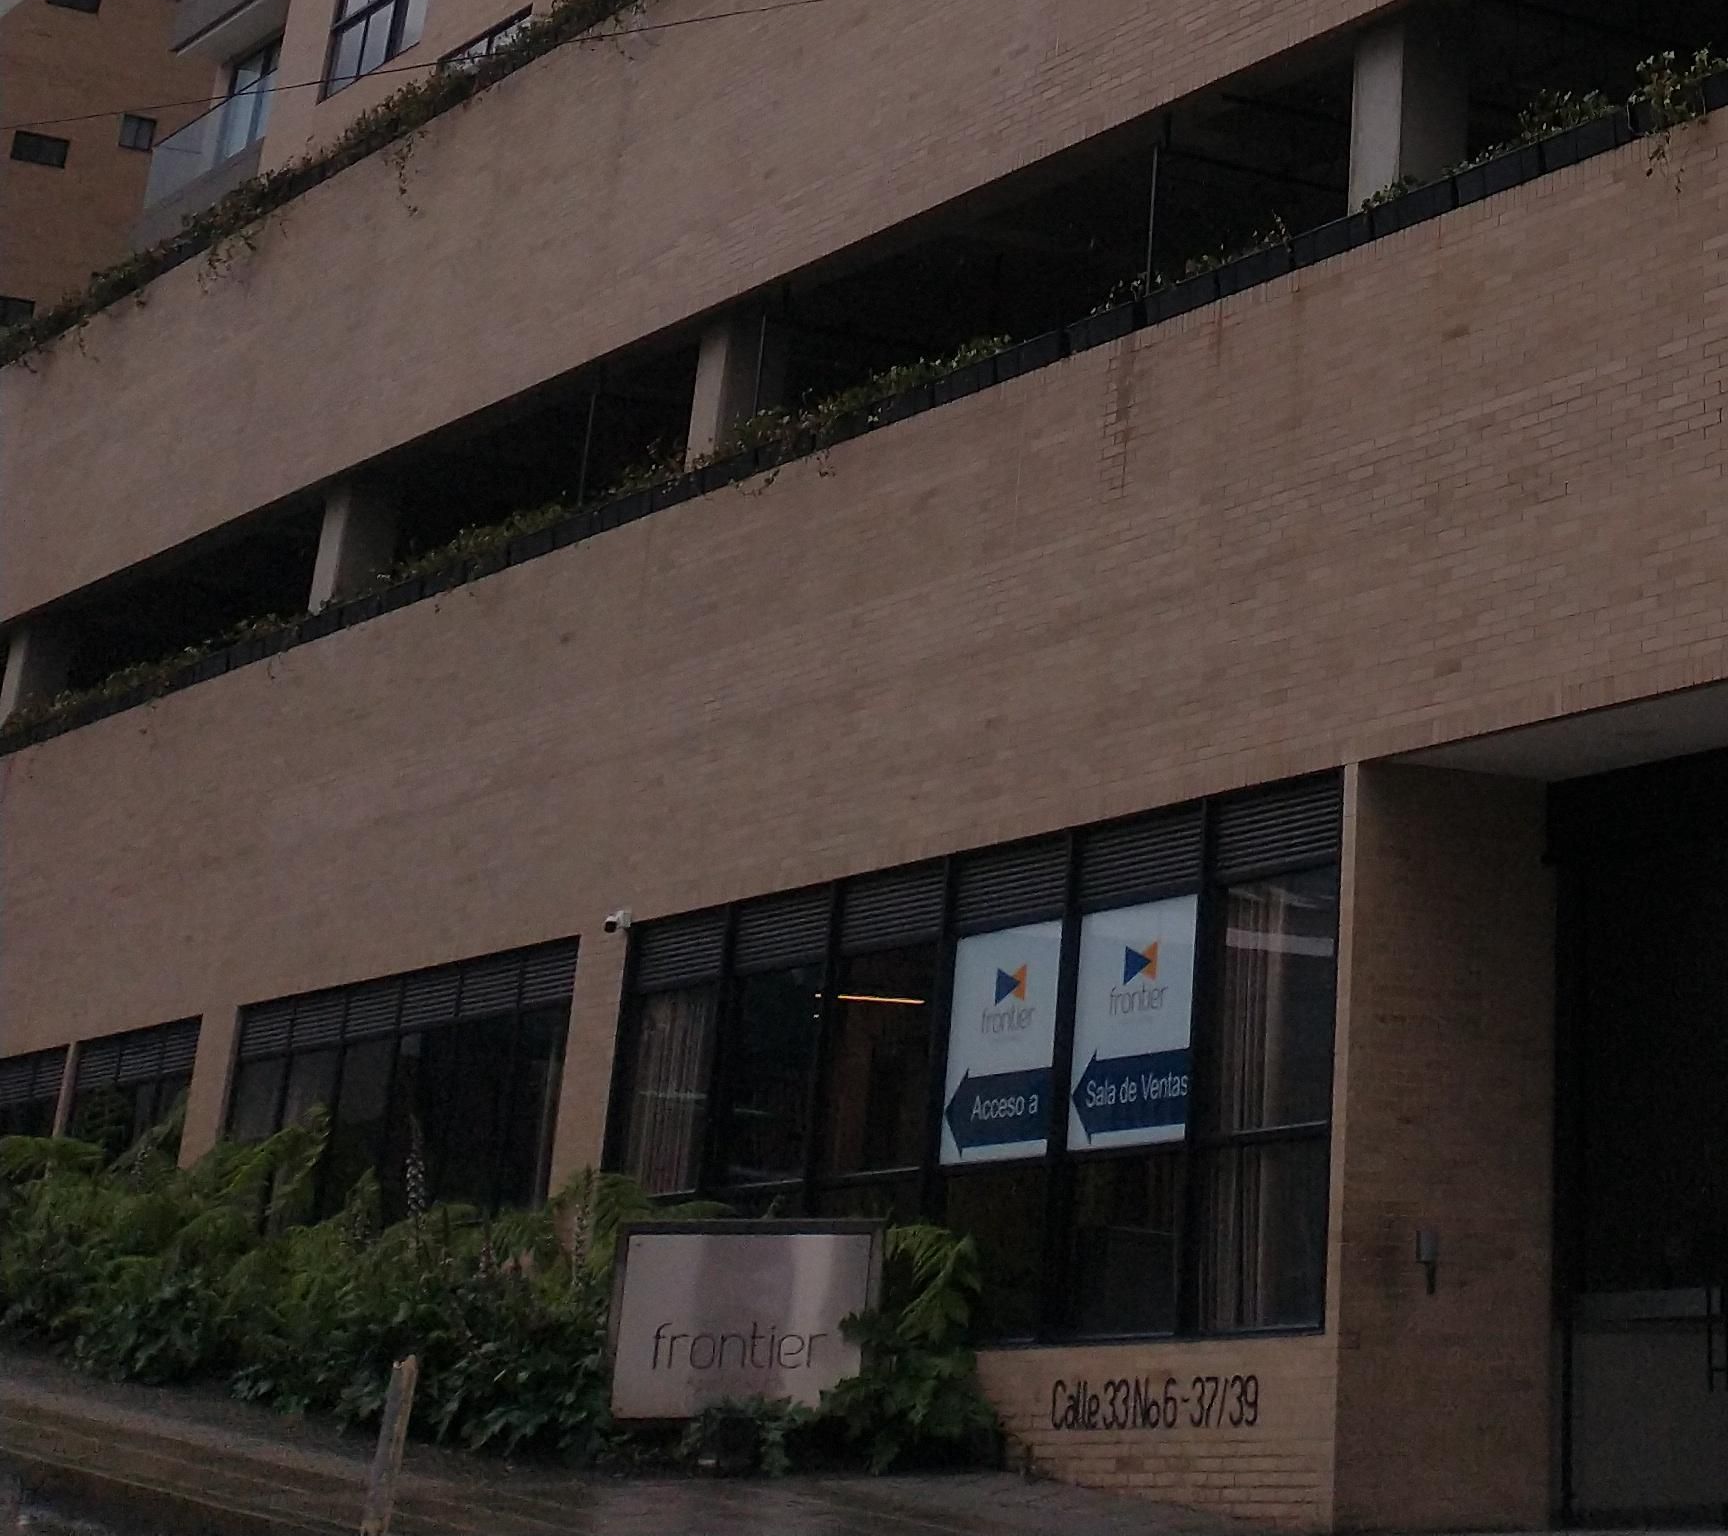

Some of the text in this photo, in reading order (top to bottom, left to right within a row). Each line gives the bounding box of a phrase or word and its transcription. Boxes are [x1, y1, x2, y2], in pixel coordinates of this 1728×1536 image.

[1109, 982, 1169, 1017] frontier
[980, 1004, 1035, 1035] frontier
[970, 1093, 1038, 1122] Acceso a
[1086, 1073, 1188, 1109] Sala de Ventas
[652, 1321, 828, 1370] frontier
[1051, 1379, 1100, 1431] Calle
[1102, 1378, 1129, 1429] 33
